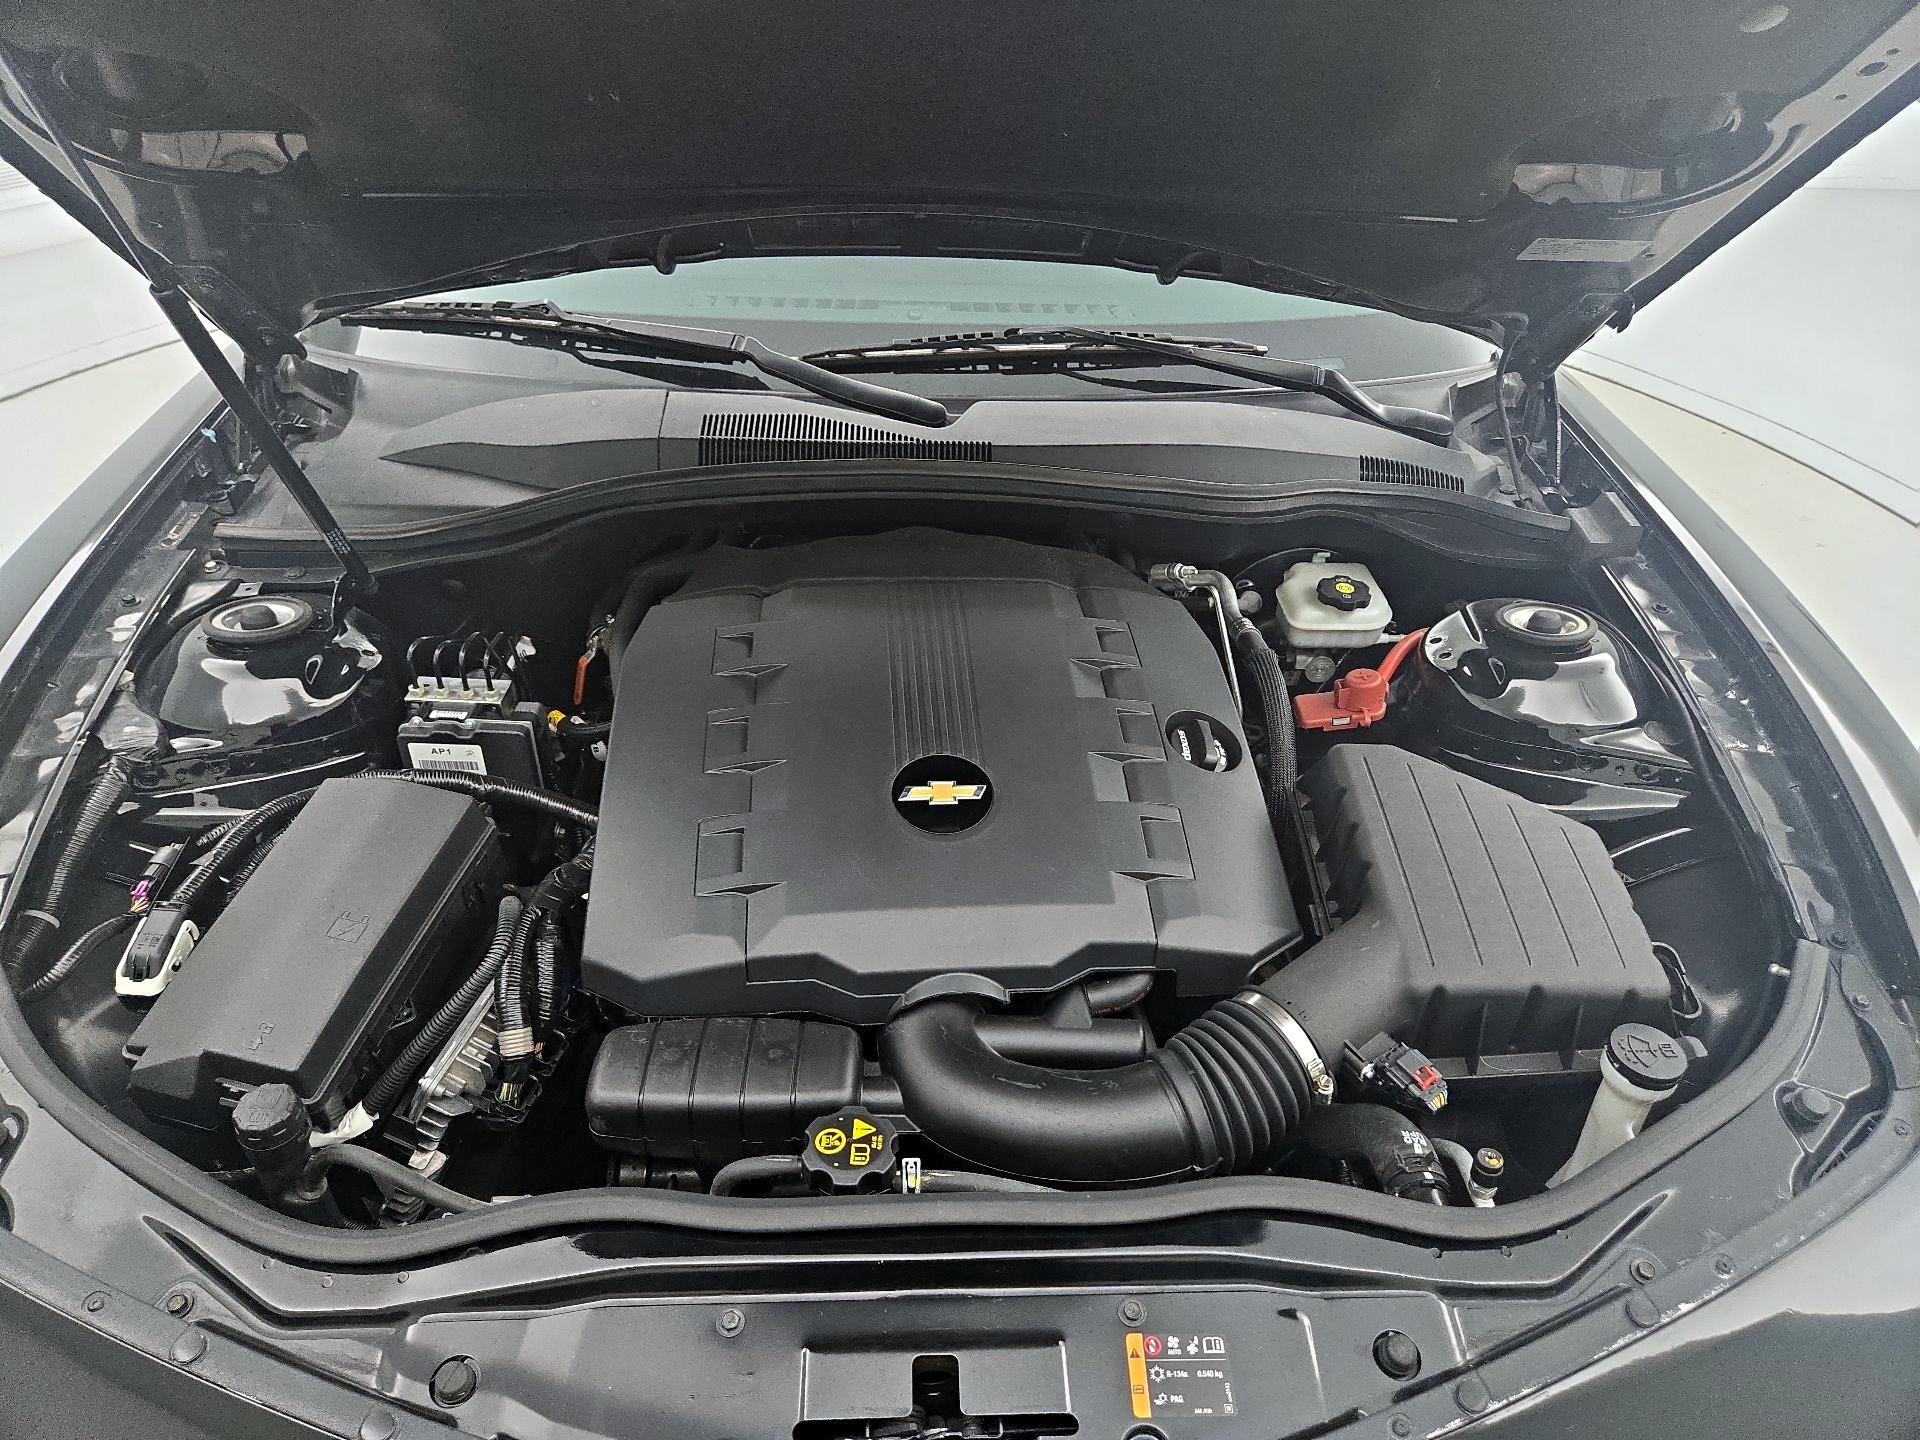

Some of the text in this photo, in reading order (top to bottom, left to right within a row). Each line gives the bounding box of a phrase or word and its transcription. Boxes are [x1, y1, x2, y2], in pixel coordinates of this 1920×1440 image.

[431, 747, 451, 755] AP1
[1166, 1369, 1223, 1379] R-134a 0.540 kg
[1170, 1395, 1184, 1403] PAG
